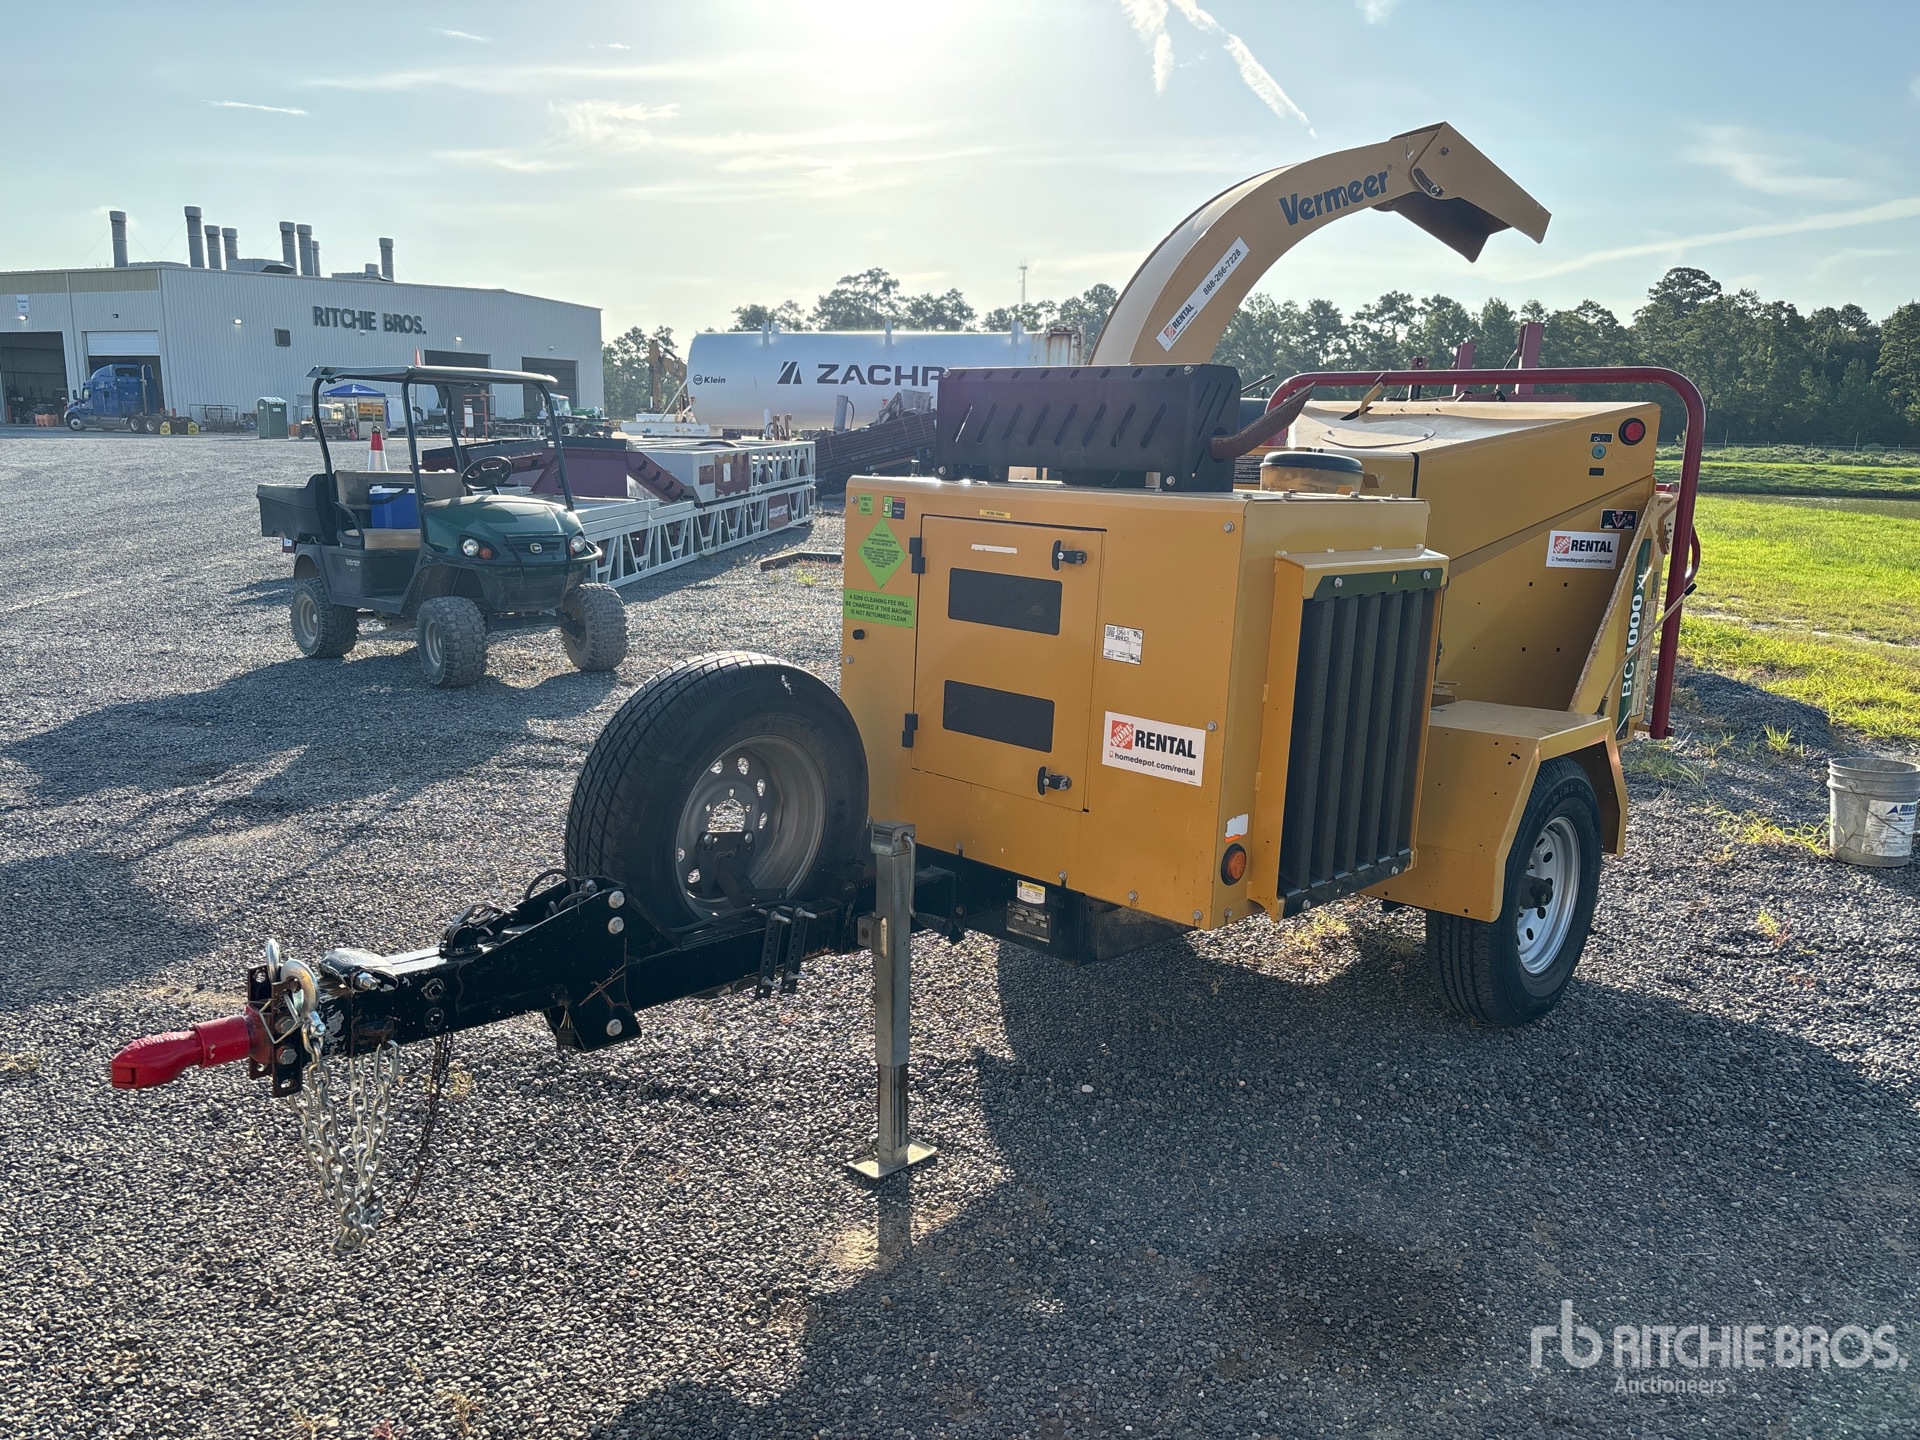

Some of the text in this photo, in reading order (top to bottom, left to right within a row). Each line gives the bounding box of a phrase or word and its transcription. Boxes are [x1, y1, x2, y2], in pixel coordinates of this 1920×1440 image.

[1278, 170, 1388, 226] Vermeer
[1202, 248, 1242, 295] 888-266-7228
[312, 305, 427, 335] RITCHIE BROS.
[1172, 303, 1195, 329] RENTAL
[703, 376, 726, 384] Klein
[1571, 539, 1613, 553] RENTAL
[852, 602, 875, 610] CHARGED
[864, 596, 887, 605] CLEANING
[866, 611, 891, 620] RETURNED
[1110, 722, 1133, 747] HOME
[1134, 729, 1197, 759] RENTAL
[1114, 752, 1196, 776] homedepot.com/rental
